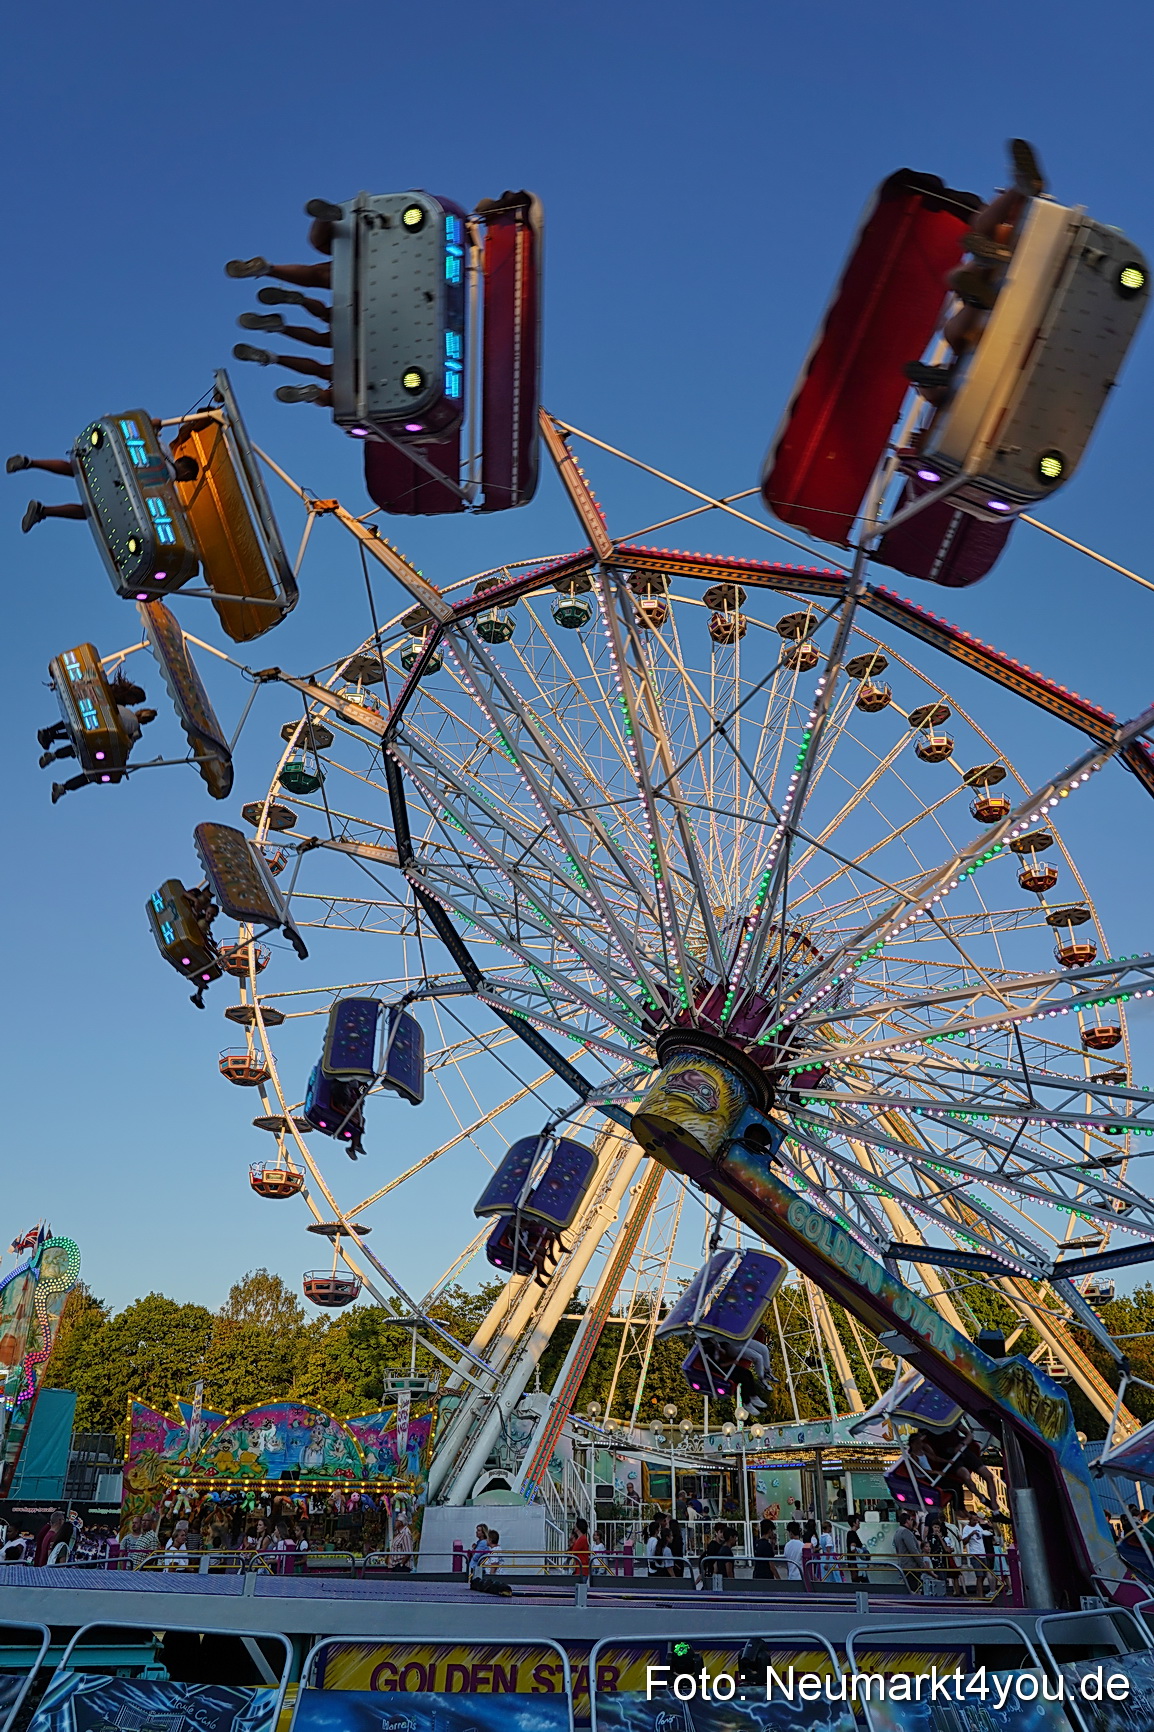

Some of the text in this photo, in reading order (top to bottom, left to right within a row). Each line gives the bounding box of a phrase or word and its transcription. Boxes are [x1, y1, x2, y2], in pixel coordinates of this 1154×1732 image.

[787, 1200, 956, 1361] GOLDEN STAR
[370, 1662, 621, 1699] GOLDEN STAR
